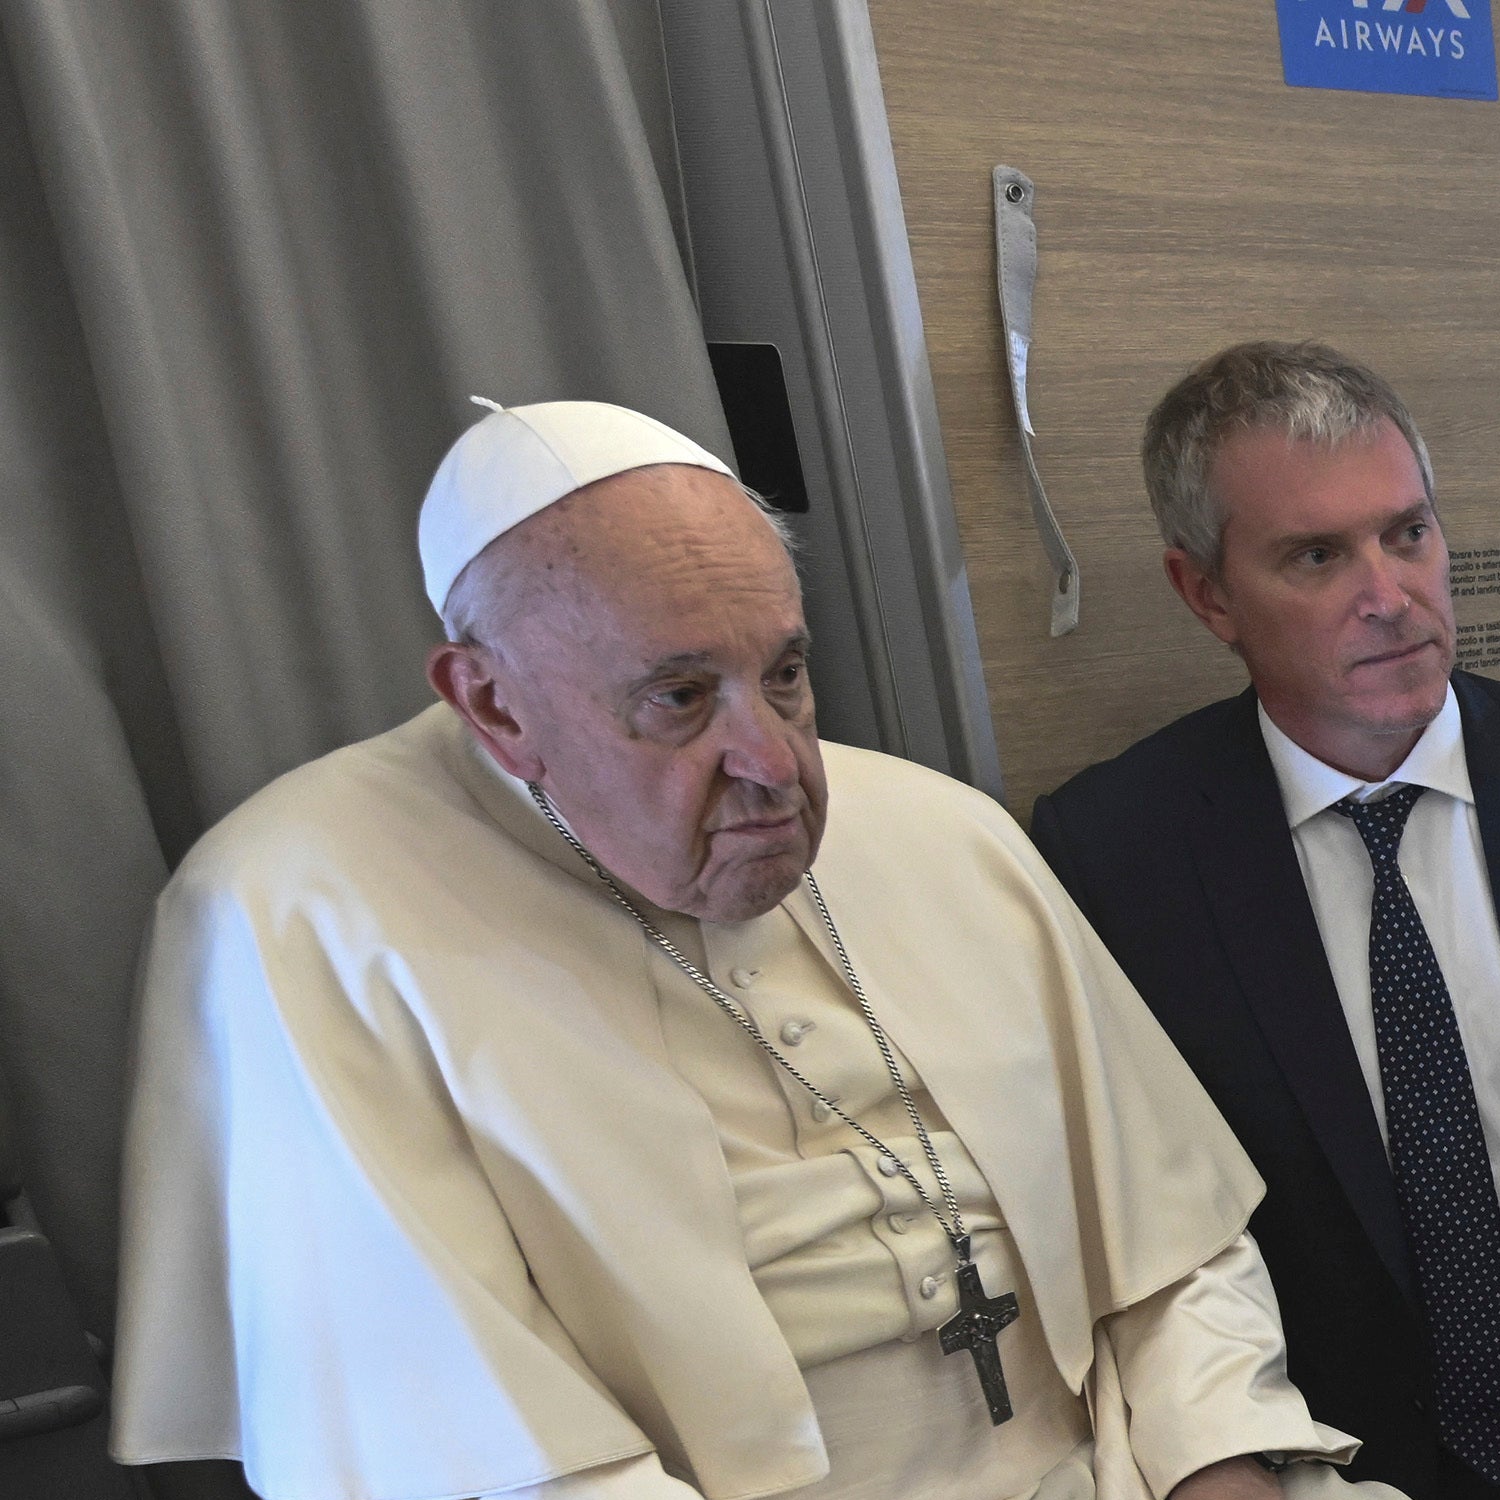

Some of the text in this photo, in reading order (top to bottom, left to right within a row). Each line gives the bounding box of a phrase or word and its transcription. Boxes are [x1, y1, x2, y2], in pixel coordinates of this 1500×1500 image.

[1315, 17, 1465, 60] AIRWAYS
[1478, 573, 1496, 581] must
[1461, 586, 1475, 596] and
[1465, 661, 1479, 670] and
